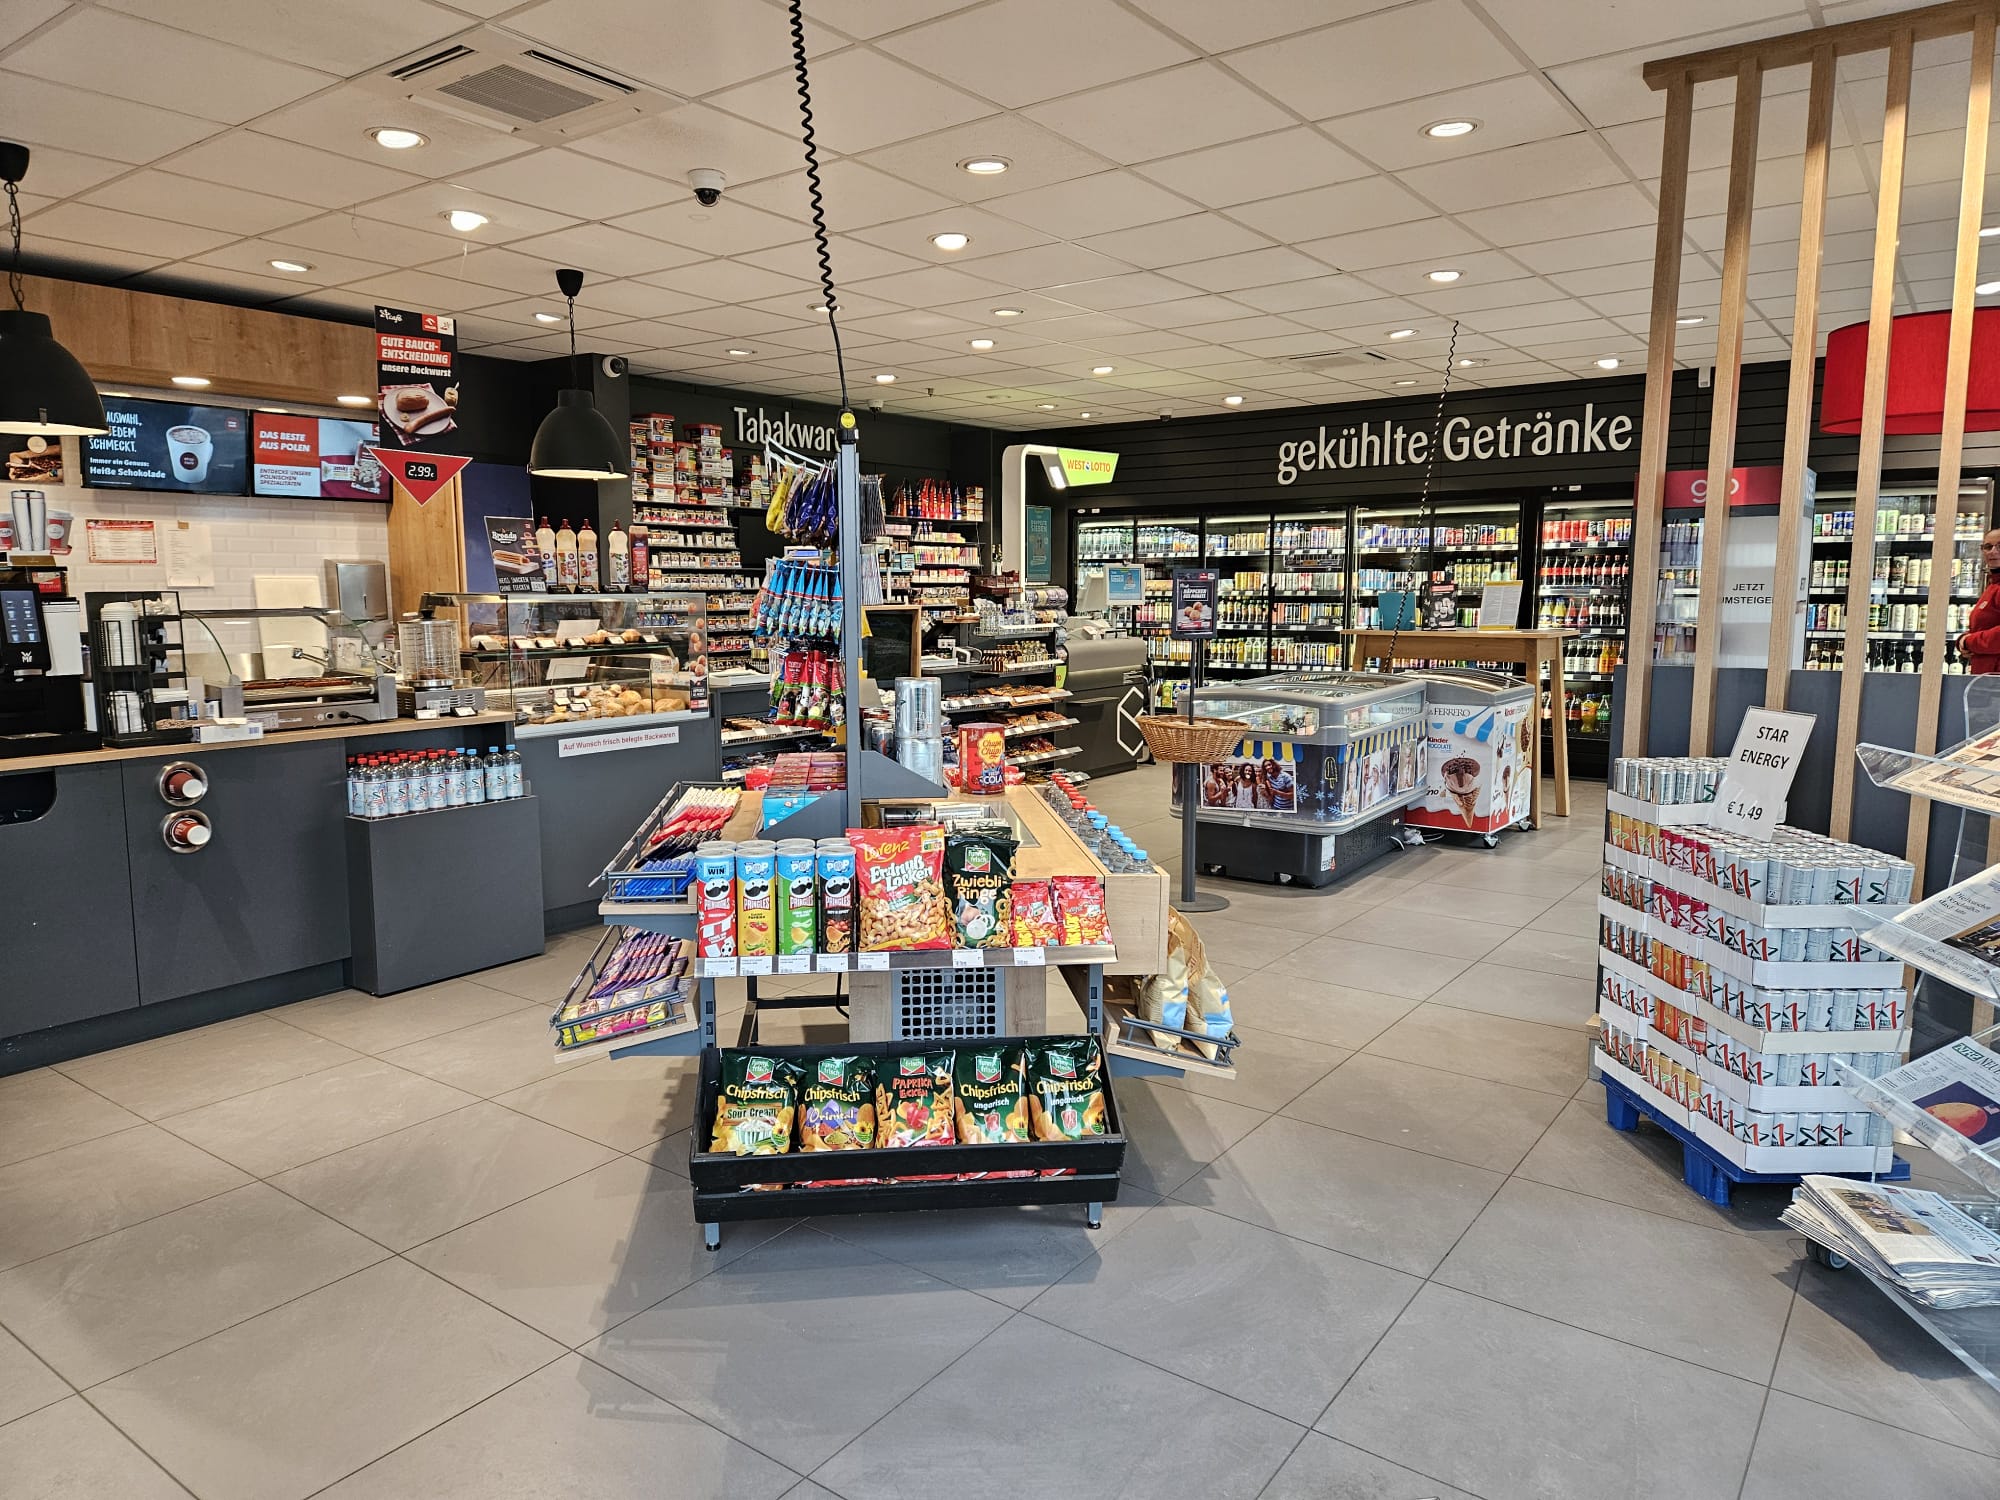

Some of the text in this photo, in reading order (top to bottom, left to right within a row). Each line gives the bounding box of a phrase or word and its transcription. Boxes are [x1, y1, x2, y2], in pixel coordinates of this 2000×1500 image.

[380, 336, 439, 351] GUTE BAUCH-
[381, 348, 448, 364] ENTSCHEIDUNG
[381, 363, 451, 377] unsere Bockwurst
[259, 431, 306, 442] DAS BESTE
[1277, 403, 1633, 485] gekühlte Getränke
[89, 438, 137, 453] SCHMECKT.
[259, 441, 311, 452] AUS POLEN
[90, 457, 111, 465] Immer
[1067, 459, 1111, 472] WEST LOTTO
[90, 467, 166, 479] Heiße Schokolade
[1434, 708, 1471, 717] FERRERO
[563, 731, 676, 751] Auf Wunsch frisch belegte Backwaren
[1757, 726, 1789, 744] STAR
[1740, 749, 1790, 770] ENERGY
[983, 776, 1003, 784] COLA
[1727, 801, 1763, 821] € 1,49
[864, 841, 910, 862] Lorenz
[870, 855, 925, 884] Erdnuß
[886, 866, 933, 892] Locken
[952, 873, 1008, 888] Zwiebli-
[825, 896, 851, 909] PRINGLES
[957, 886, 998, 905] Ringe
[743, 897, 771, 911] PRINGLES
[892, 1077, 933, 1090] PAPRIKA
[960, 1080, 1019, 1100] Chipsfrisch
[1036, 1079, 1094, 1094] Chipsfrisch
[726, 1084, 788, 1100] Chipsfrisch
[804, 1087, 861, 1103] Chipsfrisch
[973, 1097, 1010, 1110] ungarisch
[1050, 1095, 1085, 1106] ungarisch
[727, 1107, 777, 1119] Sour Cream
